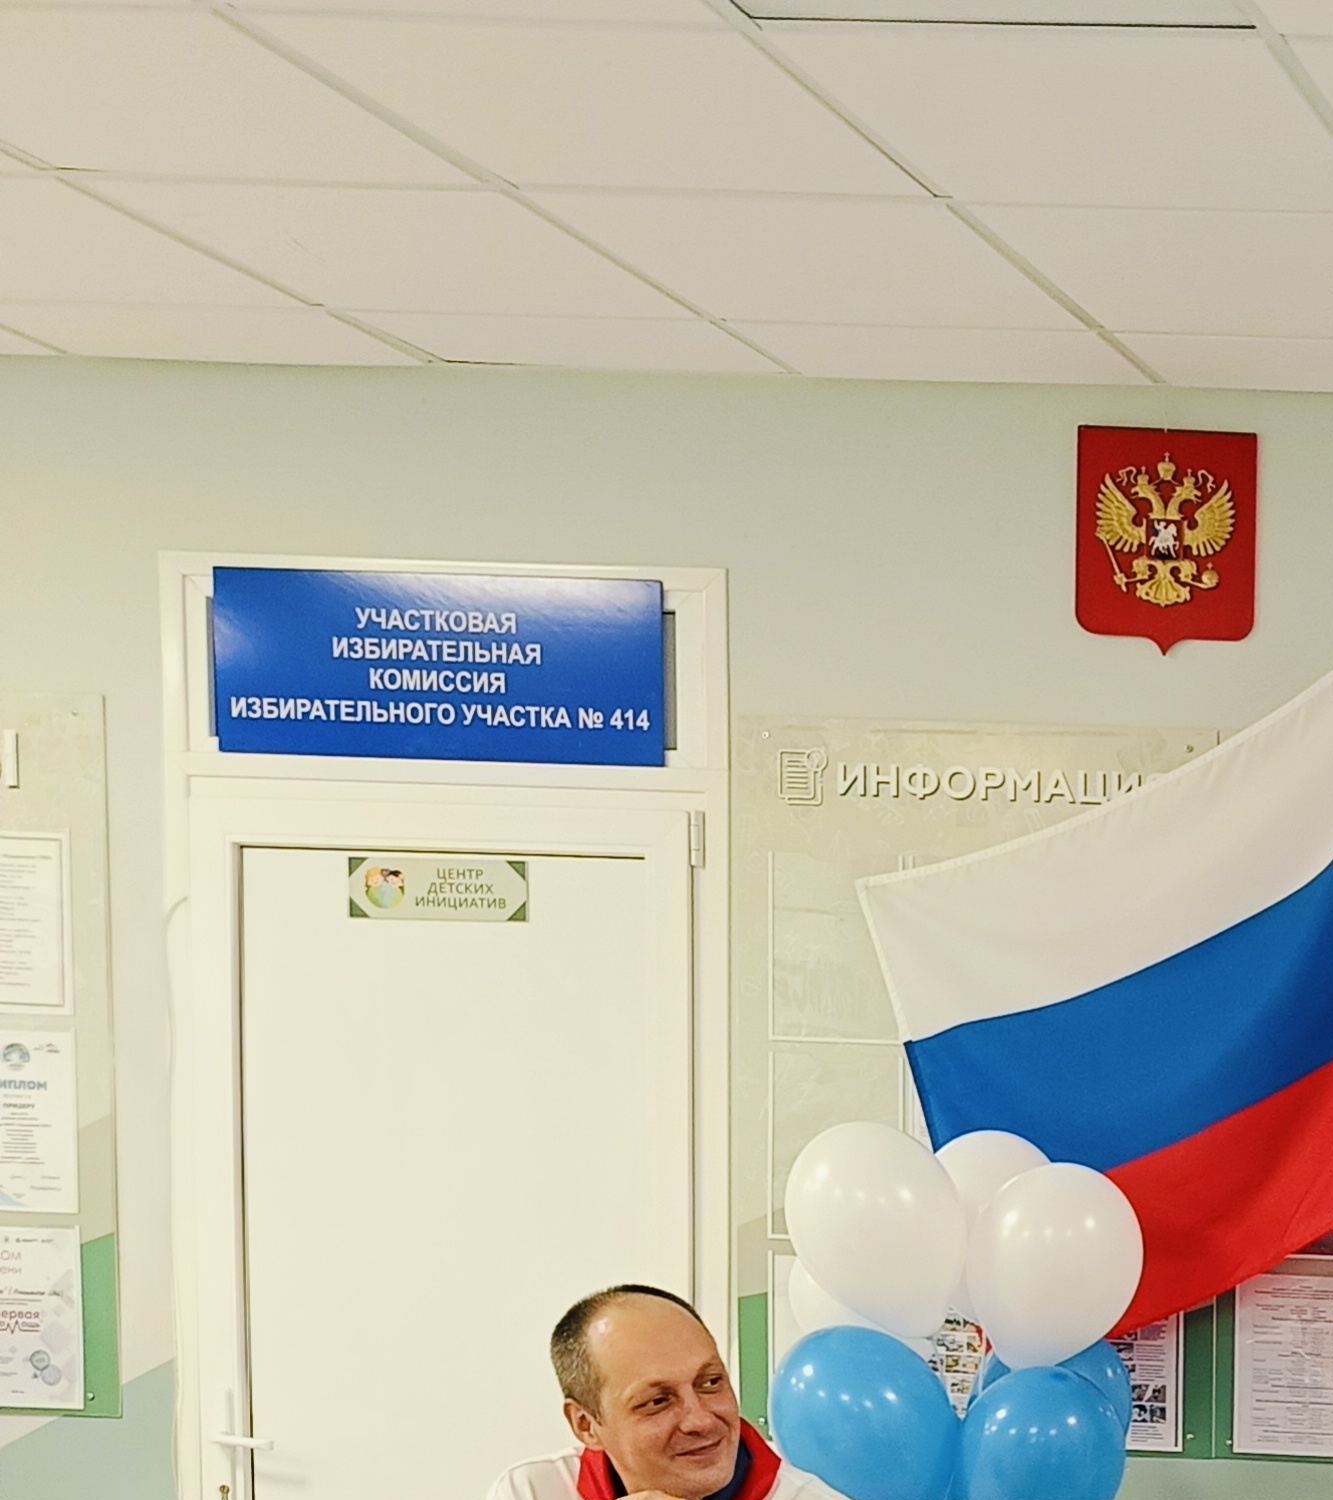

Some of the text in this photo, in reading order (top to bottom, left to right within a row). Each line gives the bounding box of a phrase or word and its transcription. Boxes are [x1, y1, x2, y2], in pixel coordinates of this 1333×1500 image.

[355, 607, 517, 634] УЧАСТКОВАЯ
[332, 636, 542, 665] ИЗБИРАТЕЛЬНАЯ
[369, 668, 506, 694] КОМИССИЯ
[230, 697, 650, 731] ИЗБИРАТЕЛЬНОГО УЧАСТКА № 414
[836, 762, 1172, 806] ИНФОРМАЦИ
[437, 867, 484, 883] ЦЕНТР
[427, 882, 494, 896] ДЕТСКИХ
[415, 896, 507, 911] ИНИЦИАТИВ
